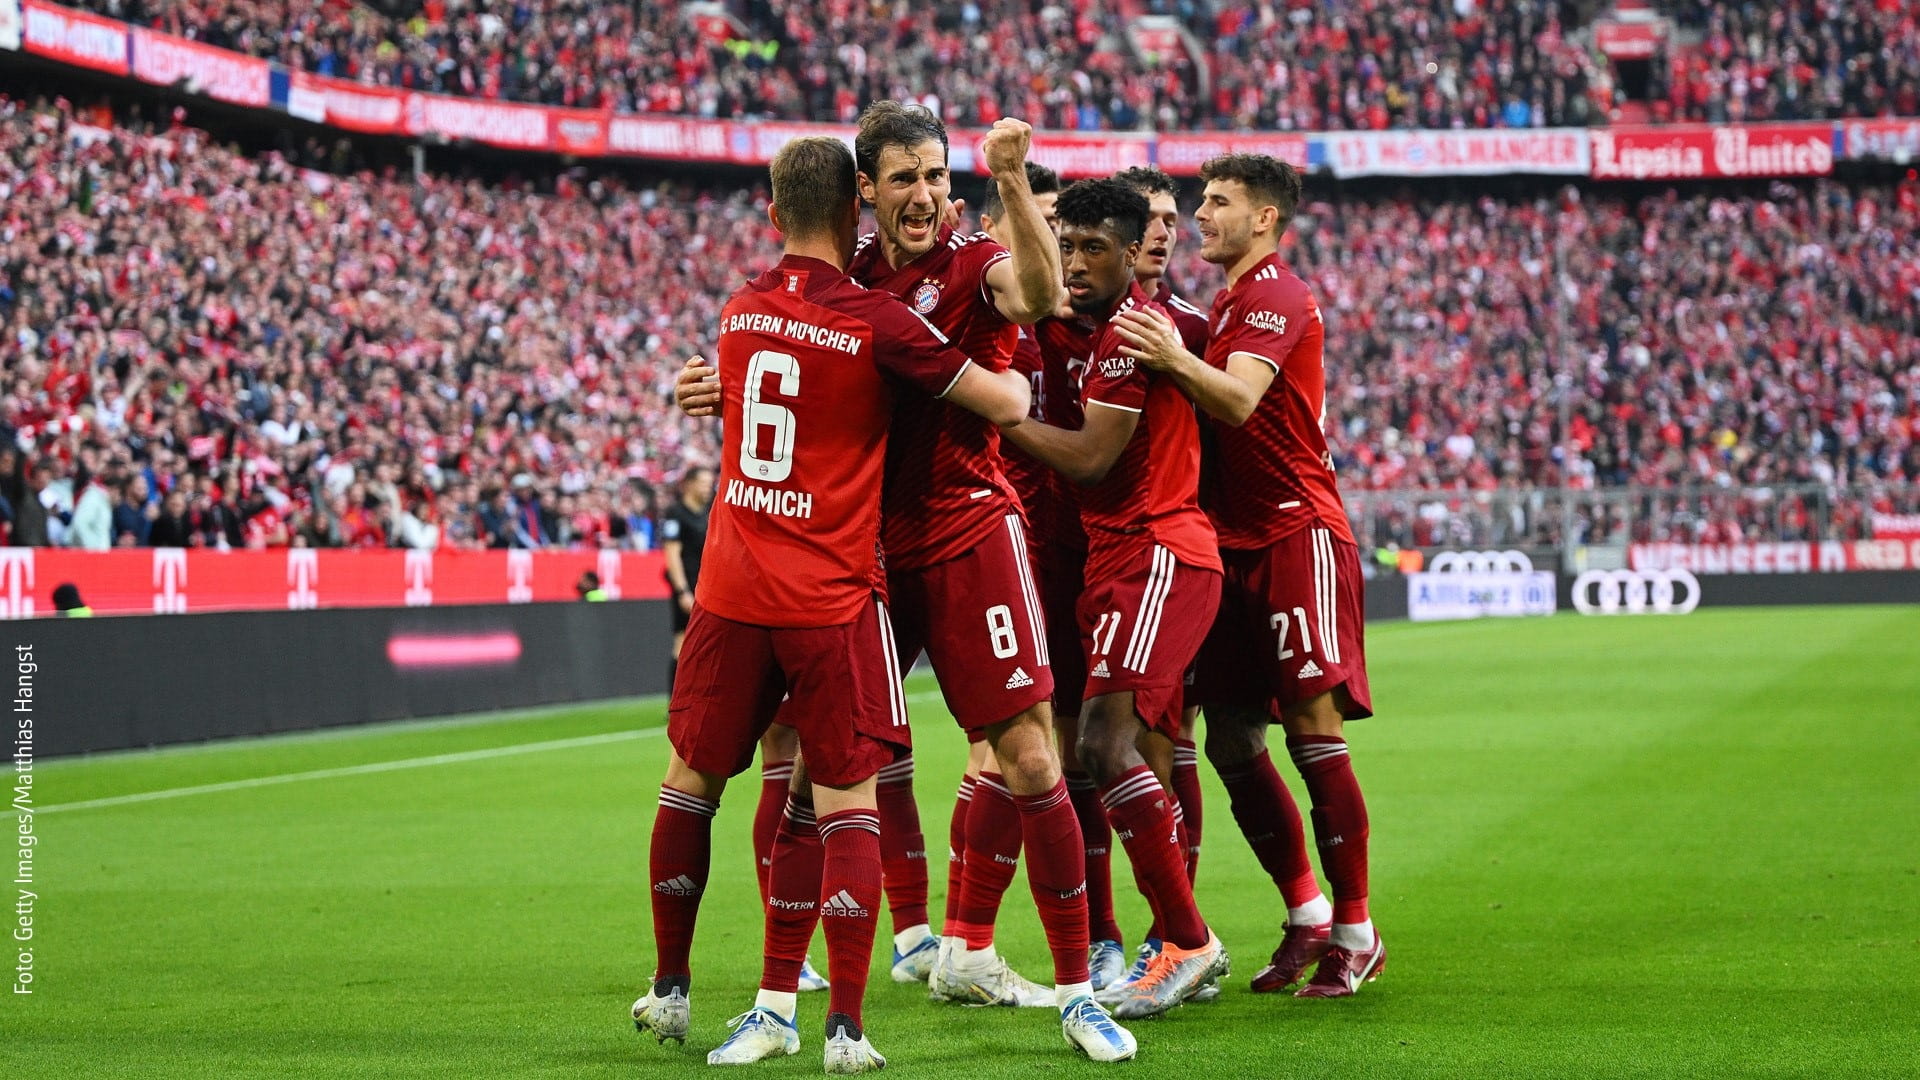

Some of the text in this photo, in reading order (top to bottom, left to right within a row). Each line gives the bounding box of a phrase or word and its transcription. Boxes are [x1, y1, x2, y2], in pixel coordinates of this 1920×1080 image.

[1592, 129, 1703, 180] Lipsia
[1713, 127, 1832, 176] United
[730, 313, 783, 334] BAYERN
[1245, 310, 1287, 329] QATAR
[1098, 356, 1136, 373] QATAR
[740, 350, 801, 482] 6
[724, 479, 812, 519] KIMMICH
[985, 605, 1019, 659] 8
[1270, 606, 1313, 661] 21
[769, 896, 815, 910] BAYERN
